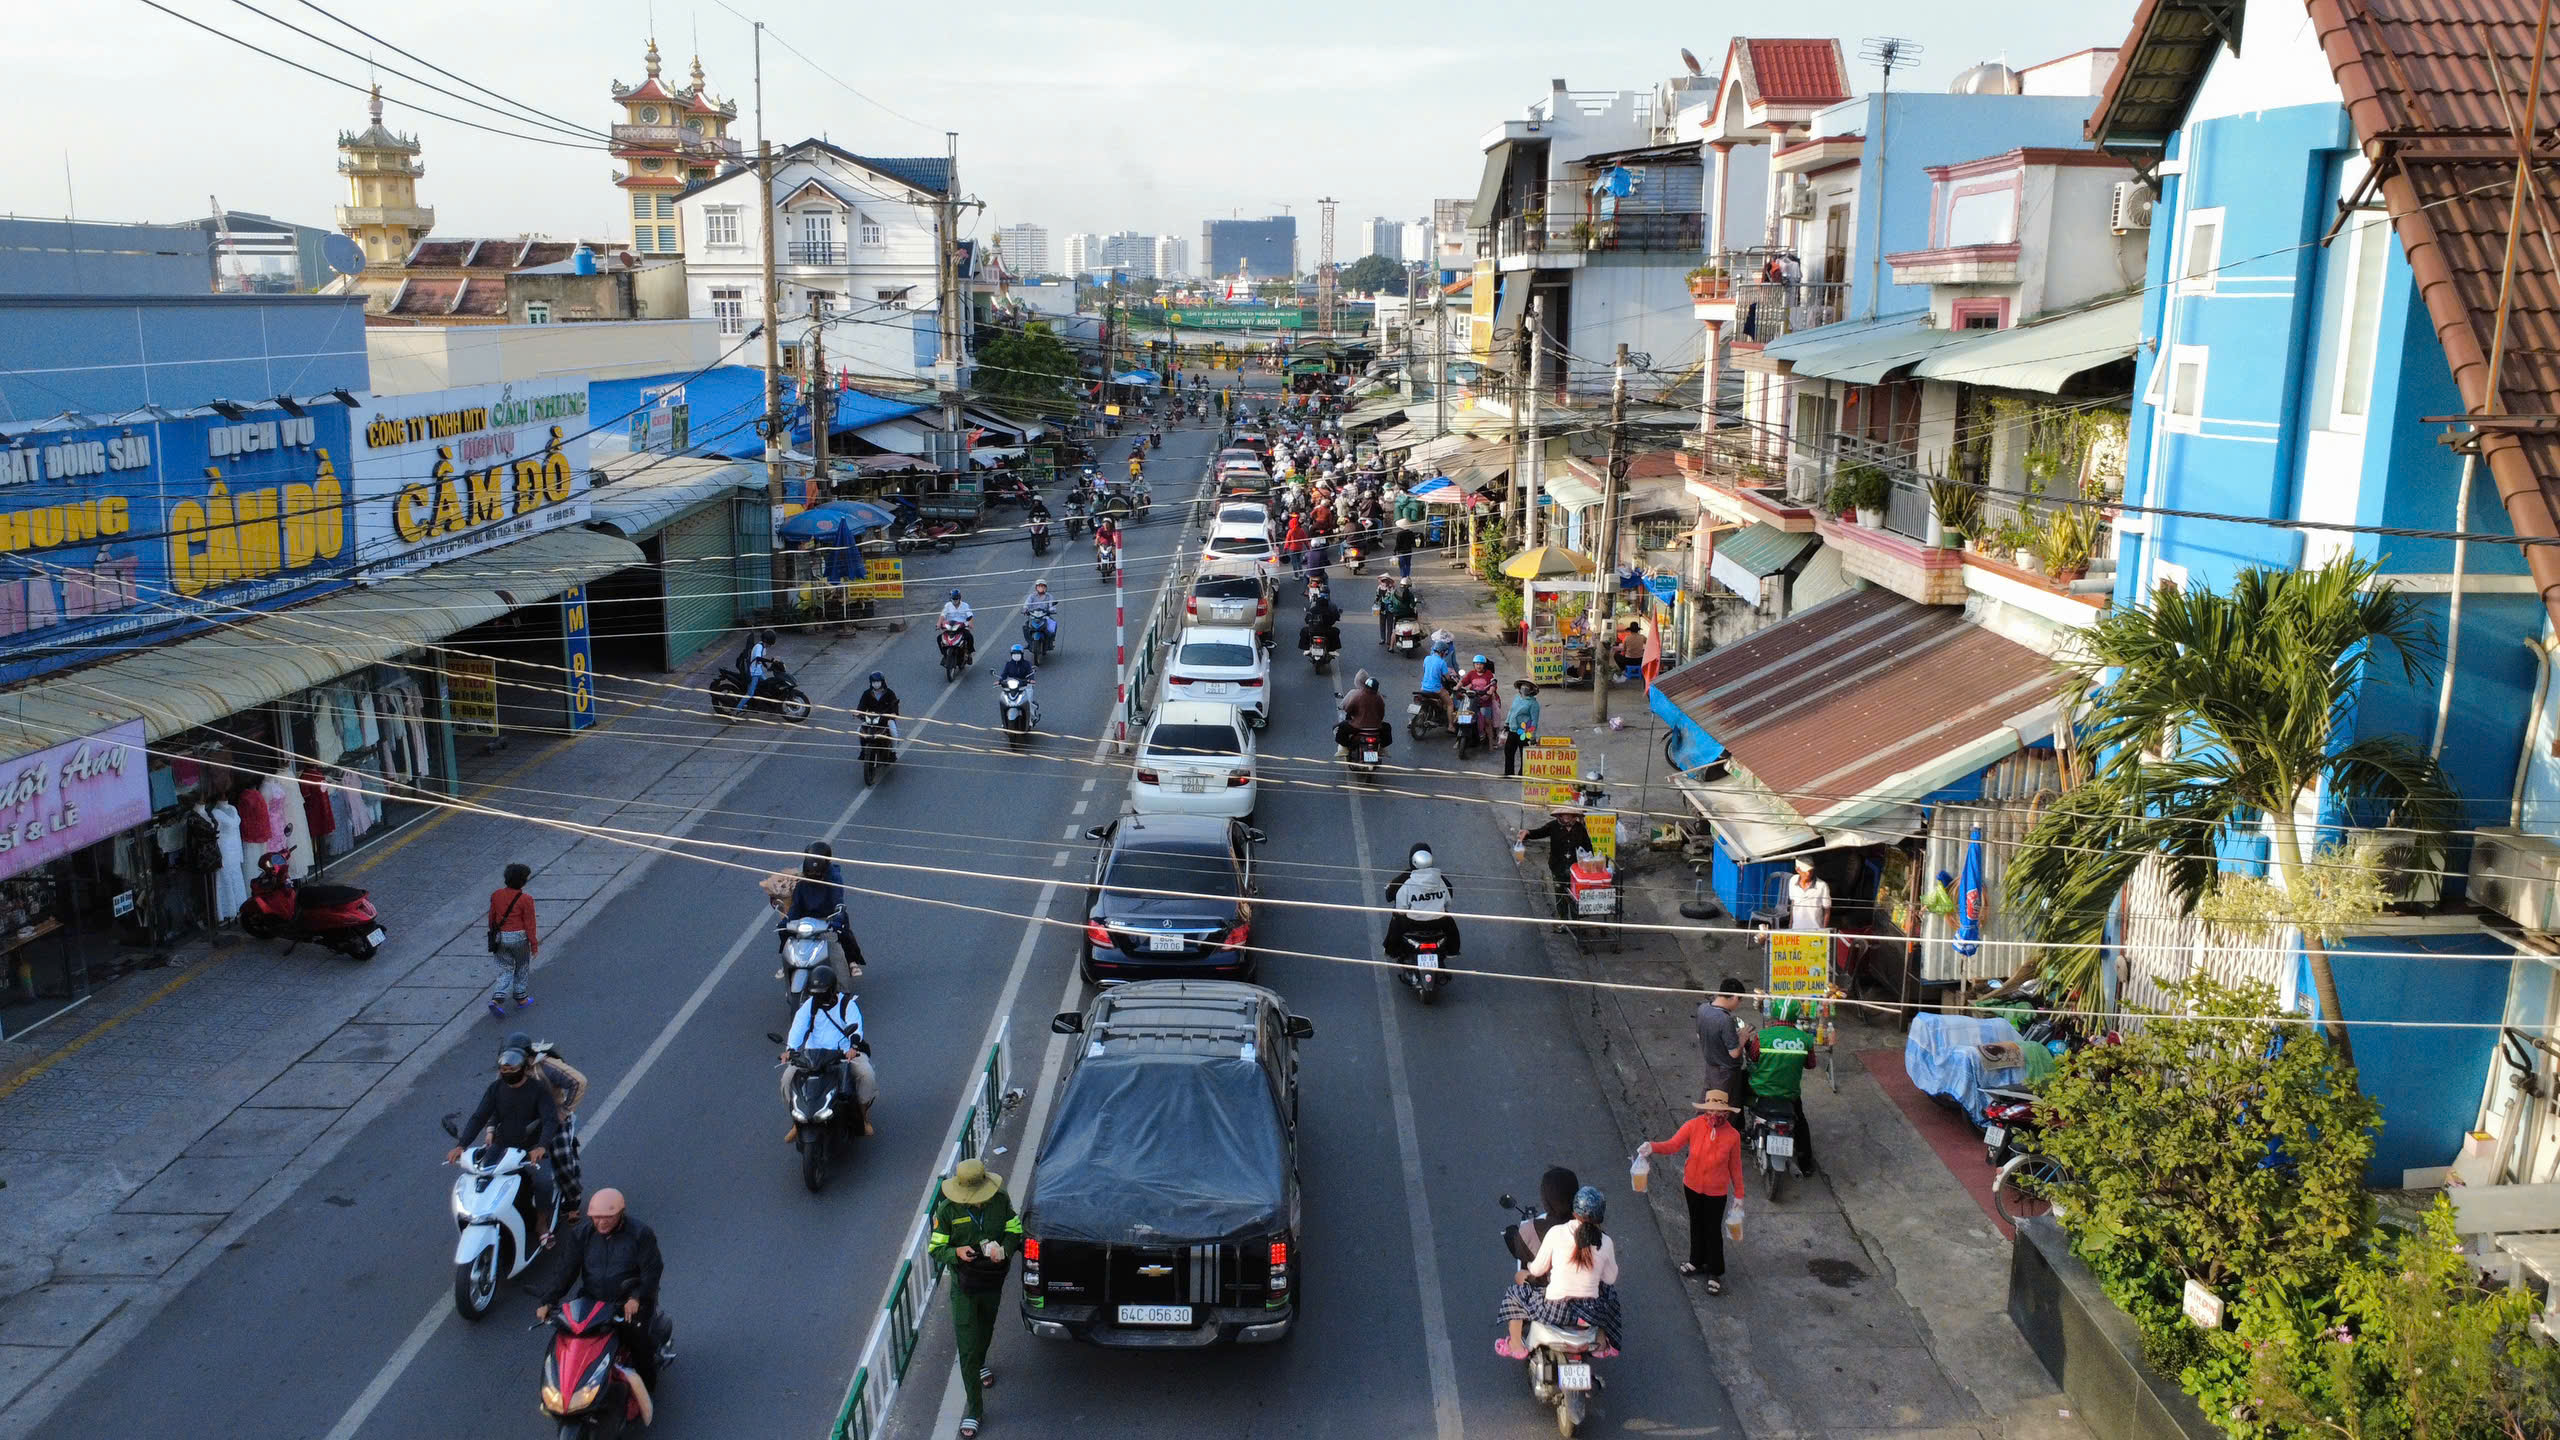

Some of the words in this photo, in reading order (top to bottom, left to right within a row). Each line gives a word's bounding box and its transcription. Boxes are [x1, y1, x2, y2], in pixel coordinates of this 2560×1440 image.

[209, 420, 278, 462] DỊCH
[279, 416, 316, 452] VỤ
[366, 413, 406, 448] CÔNG
[407, 416, 426, 442] TY
[428, 410, 461, 439] TNHH
[463, 406, 488, 433] MTV
[393, 444, 506, 544] CẦM
[168, 466, 281, 597] CẦM
[1550, 764, 1571, 776] CHIA
[25, 820, 45, 841] &
[1773, 1038, 1805, 1051] Grab
